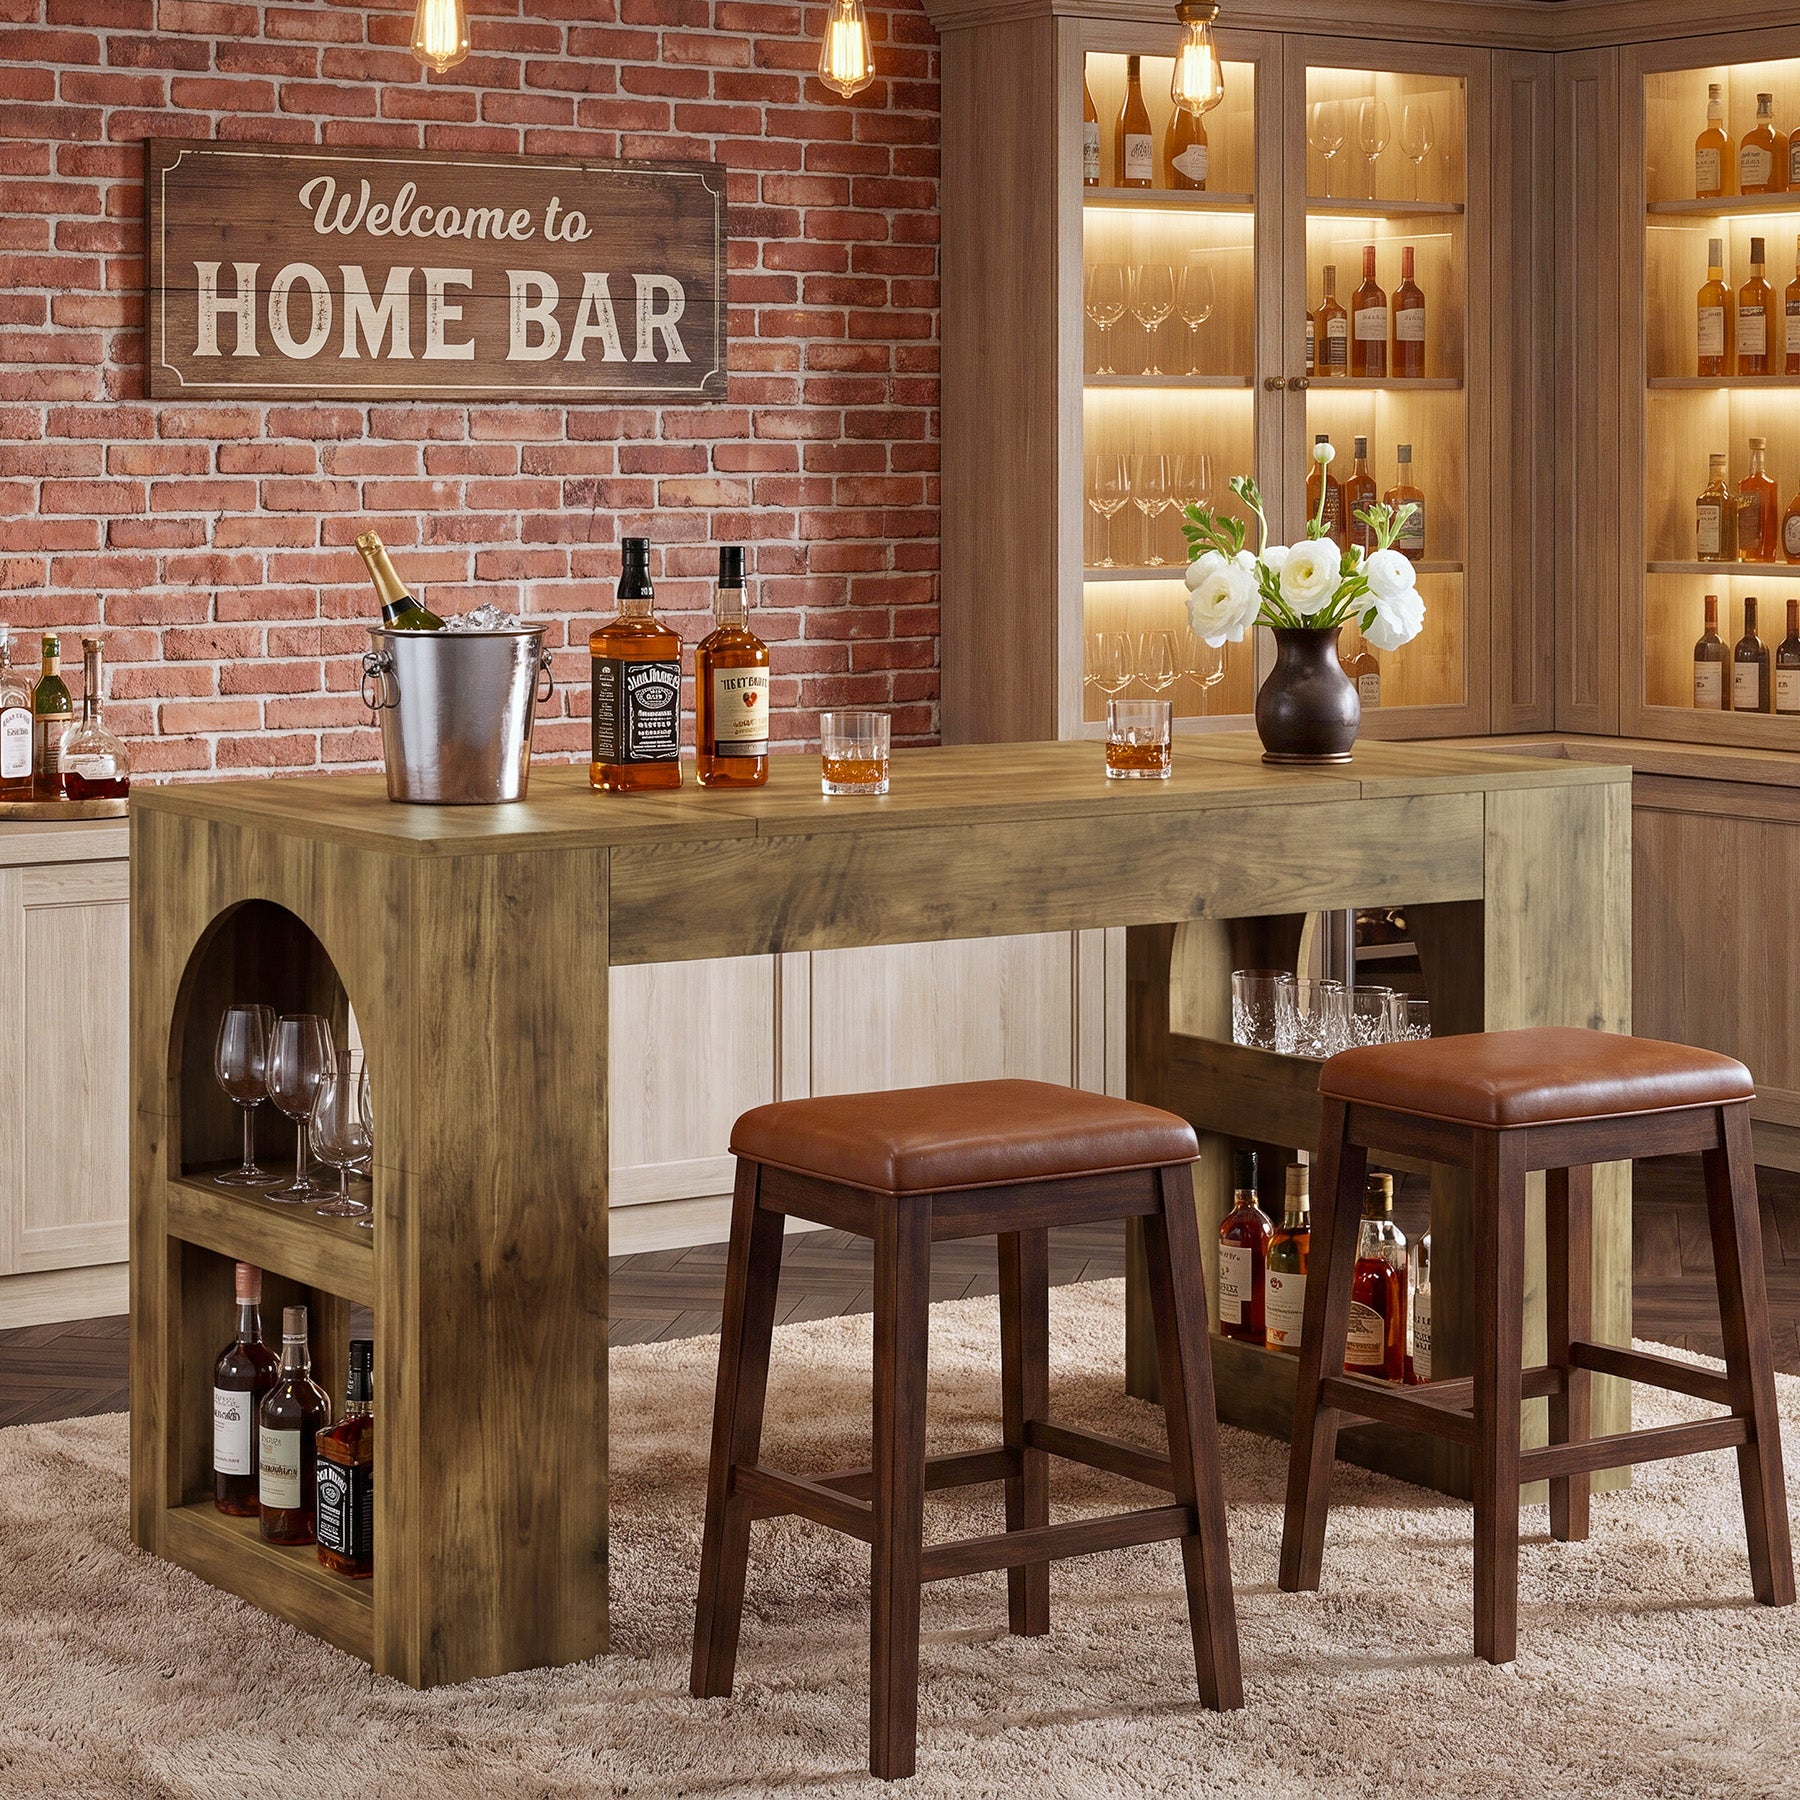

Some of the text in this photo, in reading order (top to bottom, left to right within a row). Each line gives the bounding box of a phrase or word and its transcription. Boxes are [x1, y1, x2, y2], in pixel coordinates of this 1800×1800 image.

[298, 175, 593, 243] Welcome to
[192, 261, 692, 363] HOME BAR
